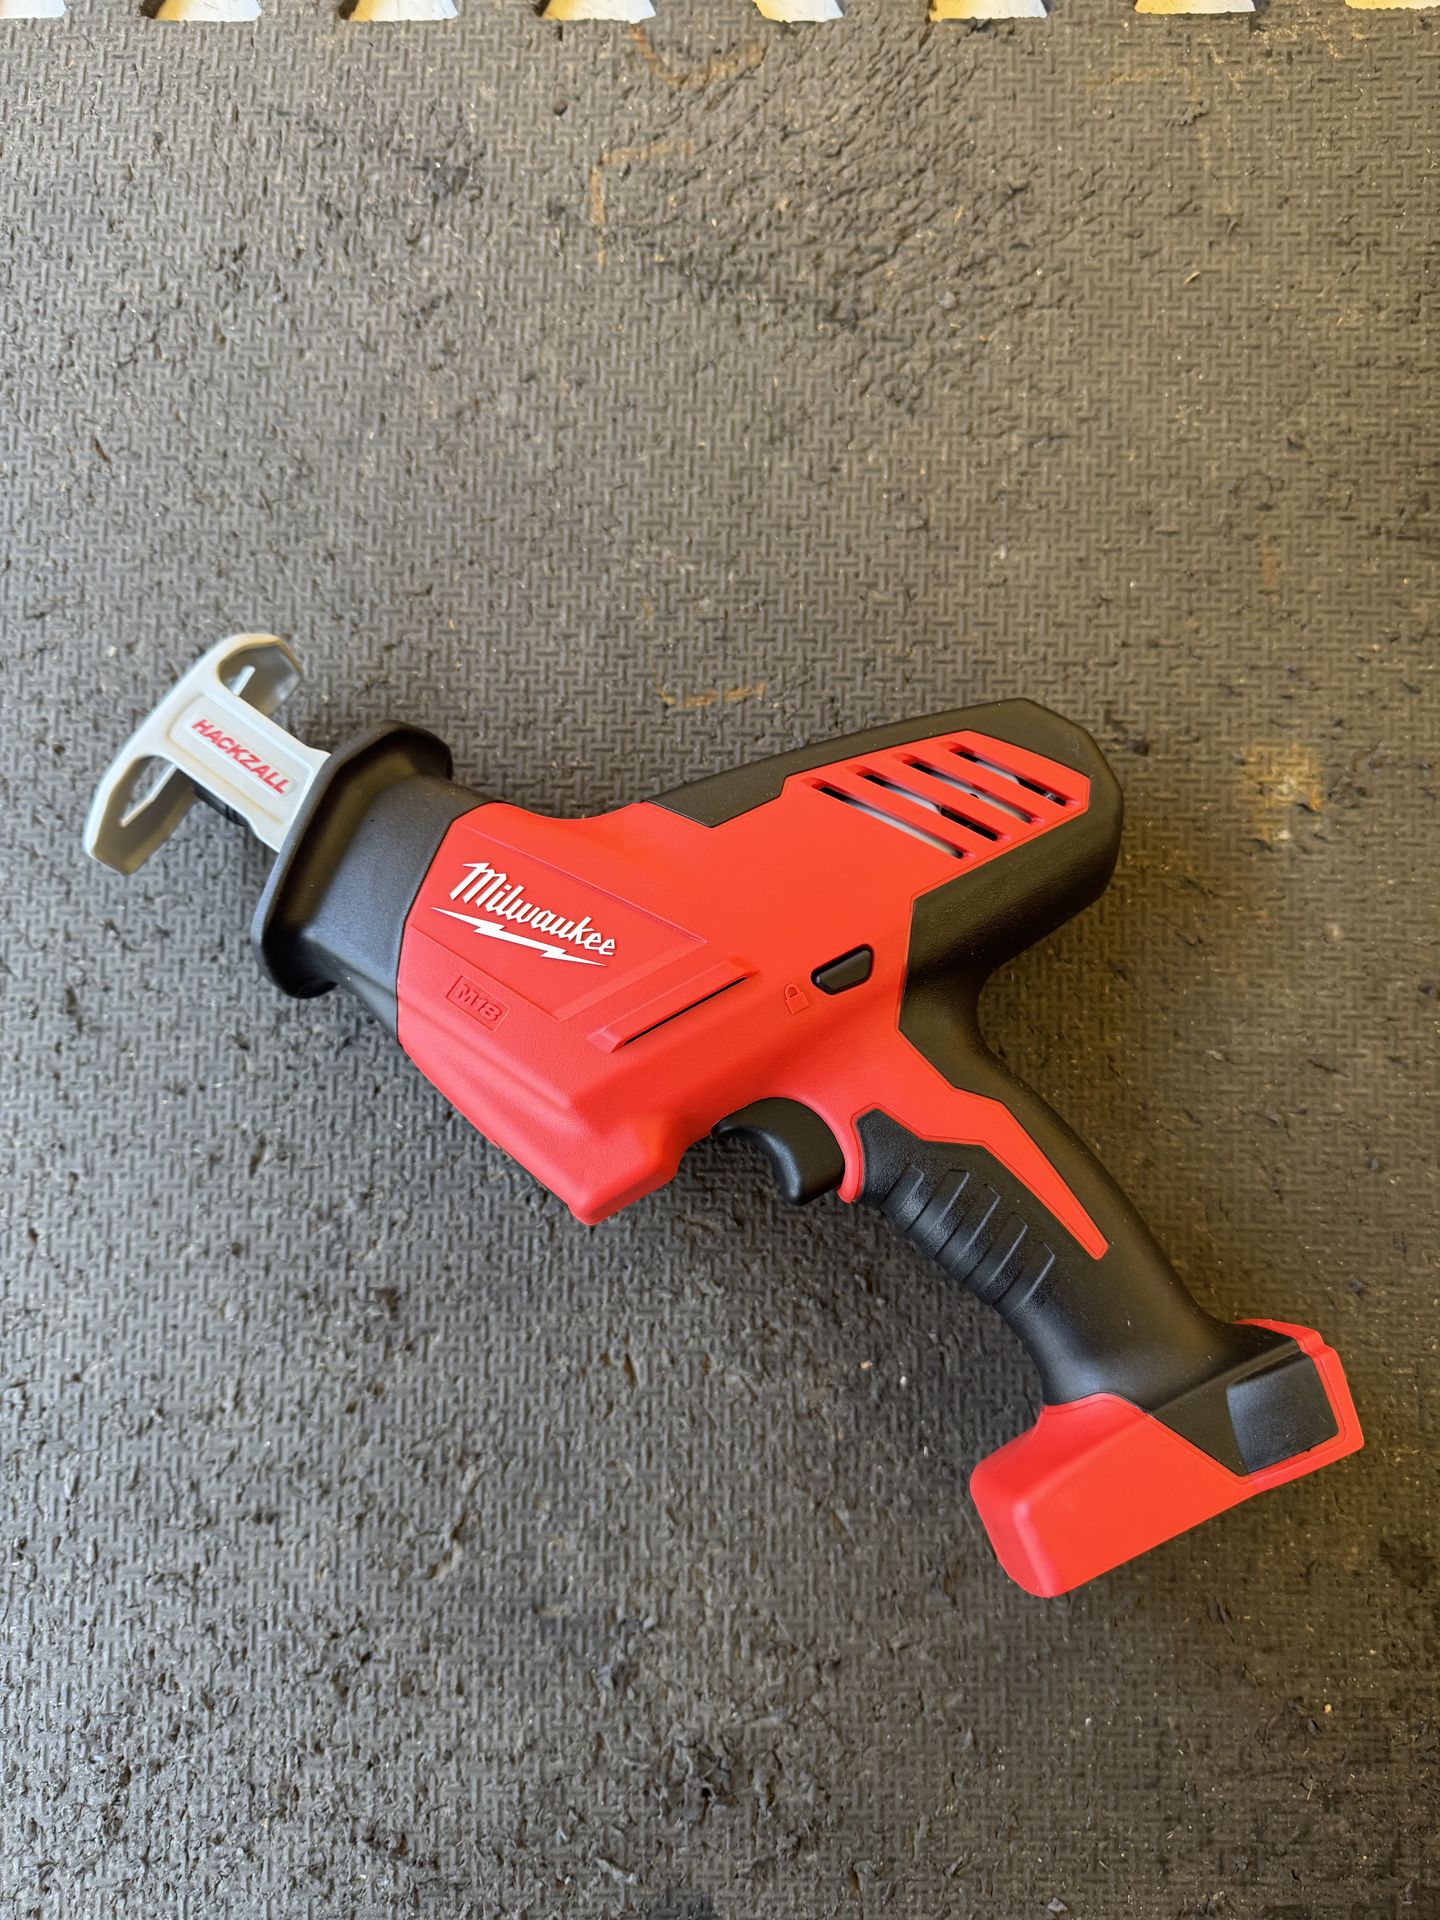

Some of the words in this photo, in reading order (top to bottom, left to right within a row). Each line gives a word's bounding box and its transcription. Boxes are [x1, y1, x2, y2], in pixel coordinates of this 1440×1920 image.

[191, 719, 289, 794] HACKZALL
[449, 862, 616, 956] Milwaukee
[455, 983, 503, 1022] M18
